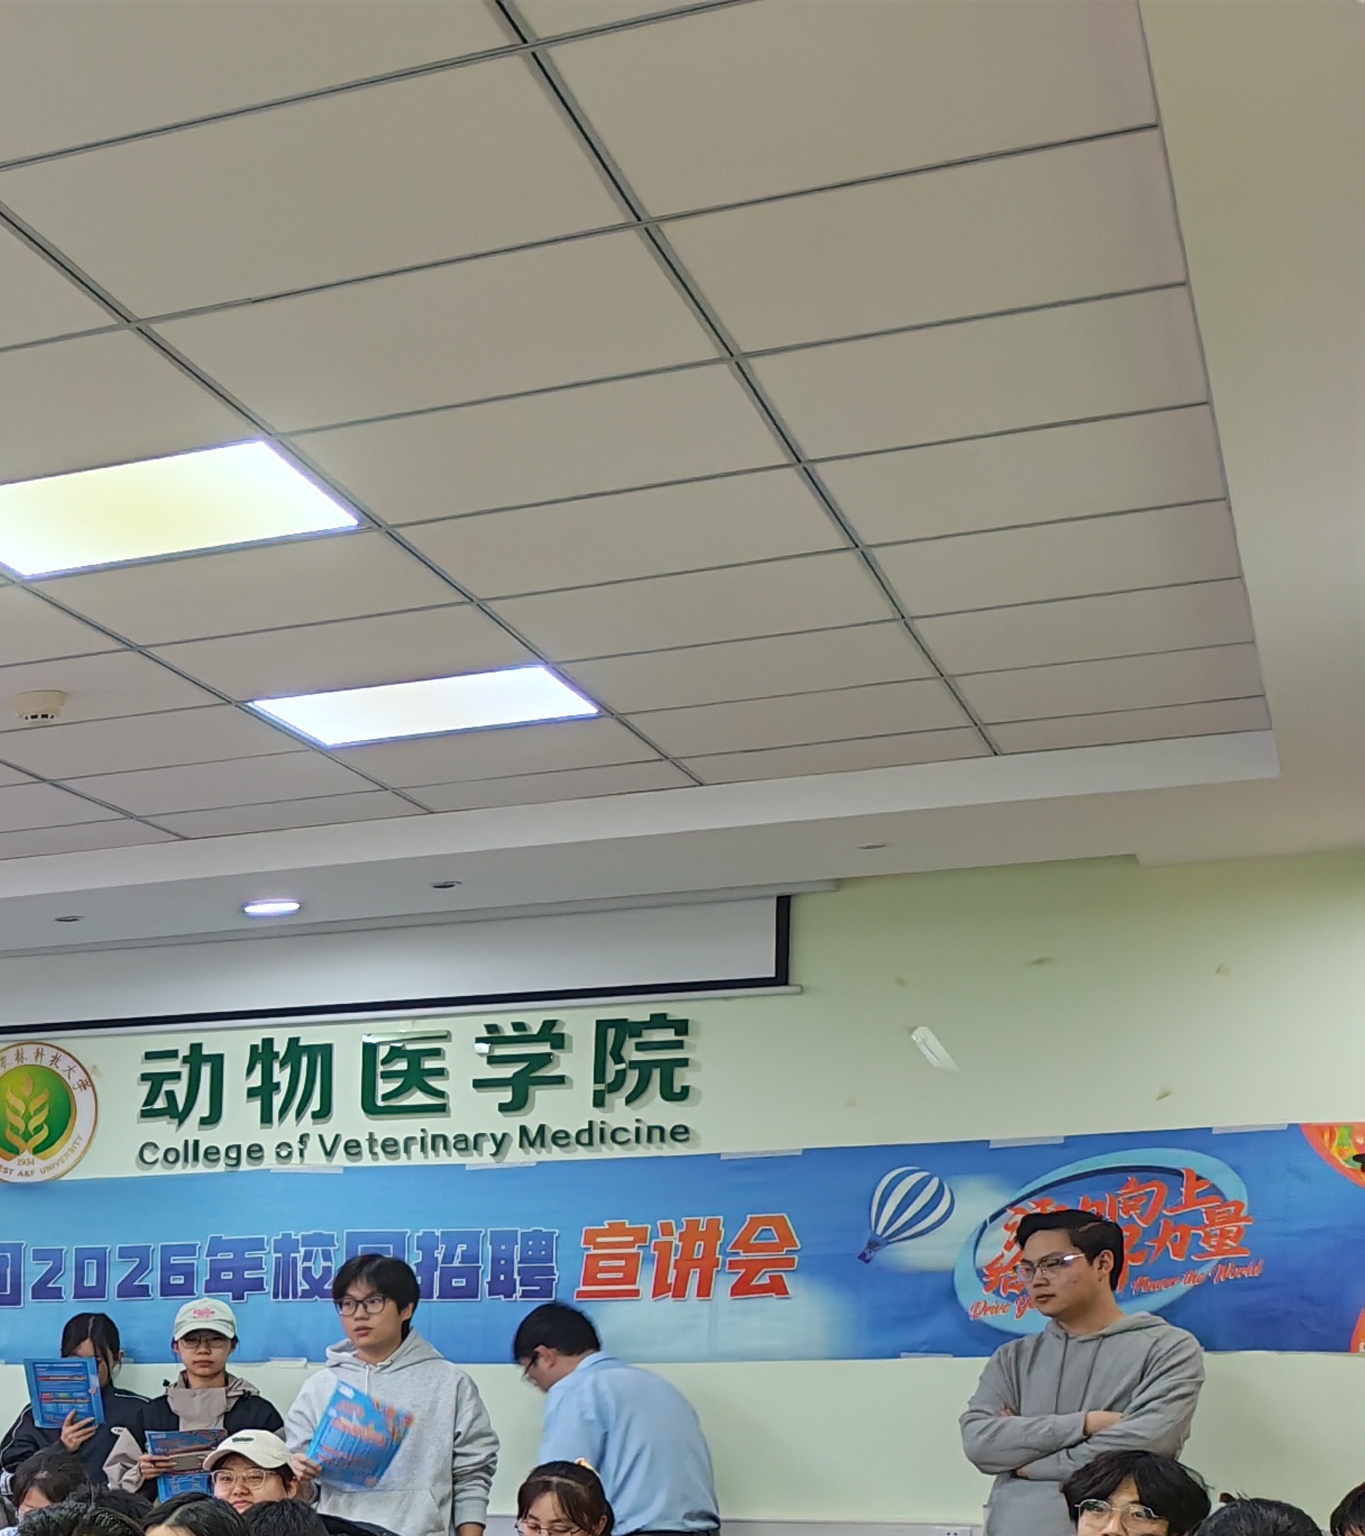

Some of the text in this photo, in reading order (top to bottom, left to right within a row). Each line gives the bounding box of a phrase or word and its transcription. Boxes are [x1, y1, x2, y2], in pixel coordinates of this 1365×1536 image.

[139, 1012, 691, 1132] 动物医学院
[17, 1169, 36, 1177] A&F
[39, 1135, 84, 1175] UNIVERSITY
[138, 1116, 692, 1167] College of Veterinary Medicine
[574, 1213, 802, 1301] 宣讲会
[1181, 1270, 1207, 1287] the
[1209, 1260, 1266, 1285] World
